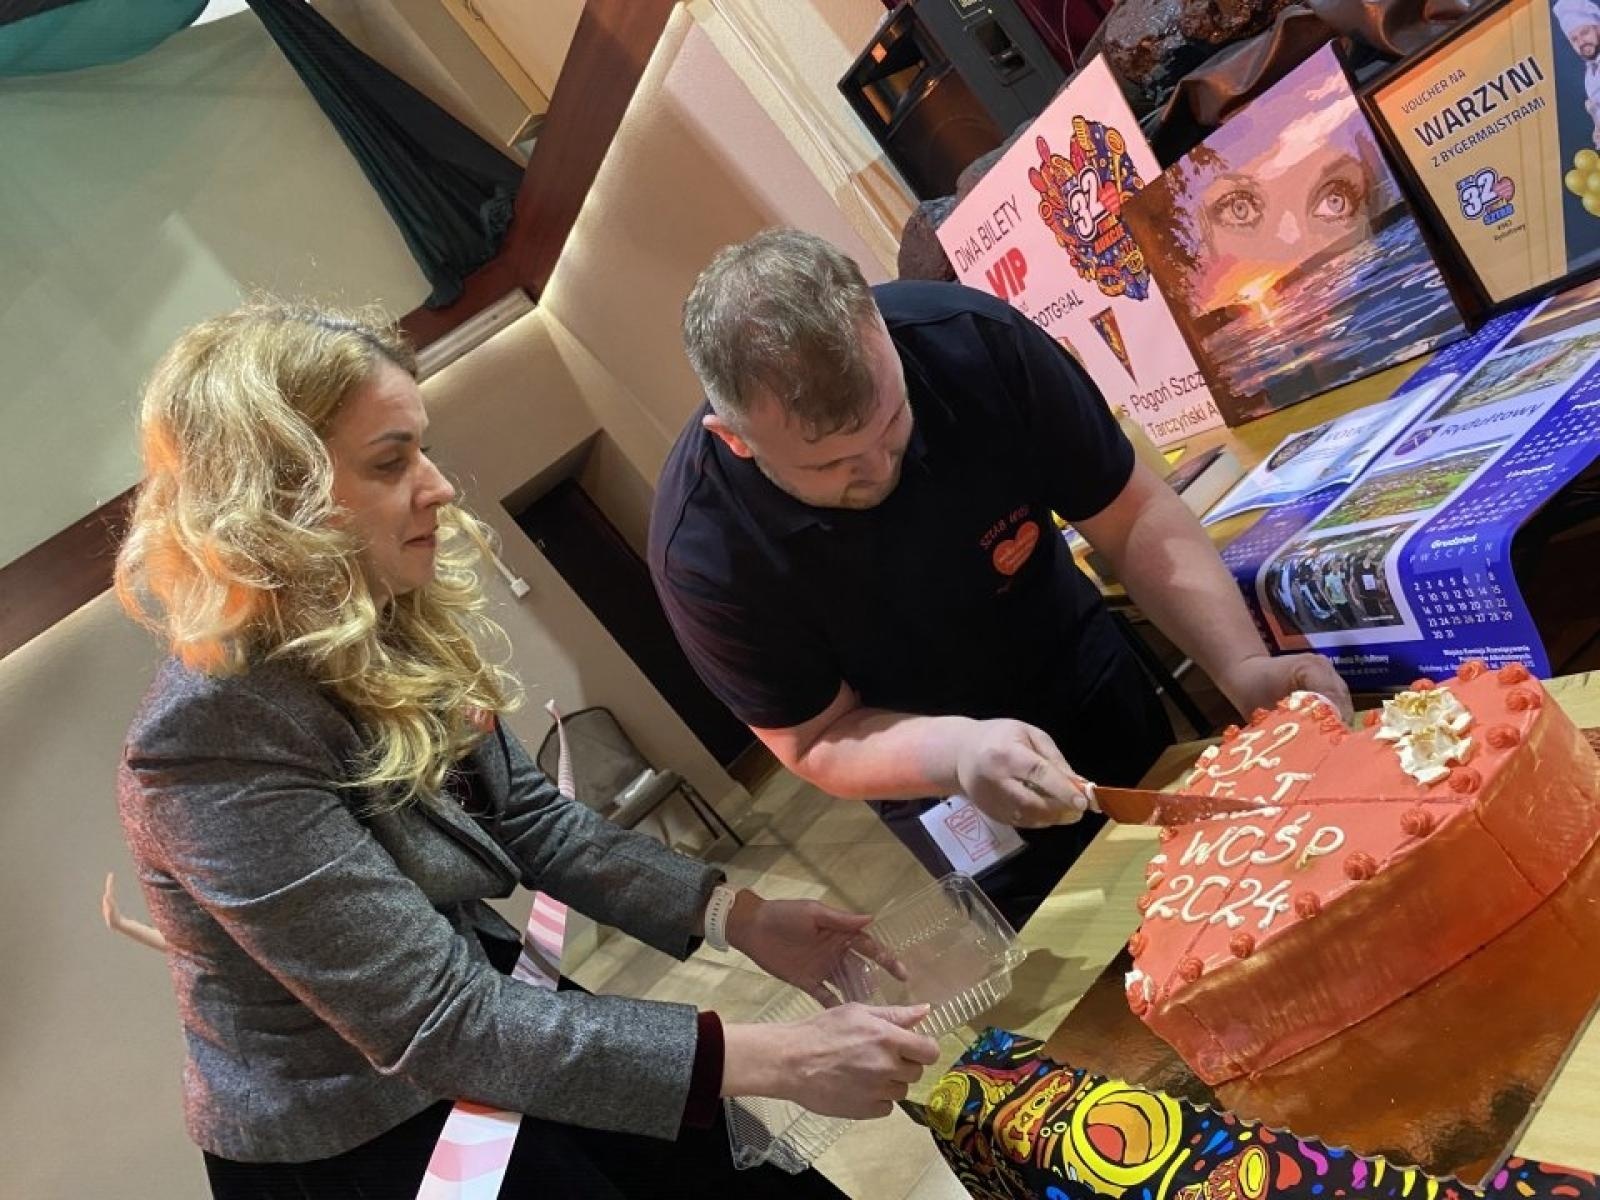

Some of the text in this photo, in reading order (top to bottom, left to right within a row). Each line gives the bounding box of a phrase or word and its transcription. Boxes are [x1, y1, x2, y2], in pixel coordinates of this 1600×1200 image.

[1401, 69, 1466, 114] VOUCHER NA
[1414, 56, 1544, 147] WARZYNI
[1431, 96, 1546, 168] Z BYGERMAJSTRAMI
[1069, 165, 1111, 241] 32
[1461, 169, 1499, 217] 32
[954, 194, 1022, 273] DWA BILETY
[985, 247, 1028, 300] VIP
[1130, 381, 1172, 413] Pogoń
[1170, 371, 1206, 396] Szcz
[1146, 400, 1220, 439] Tarczyński A
[1207, 722, 1299, 778] 32
